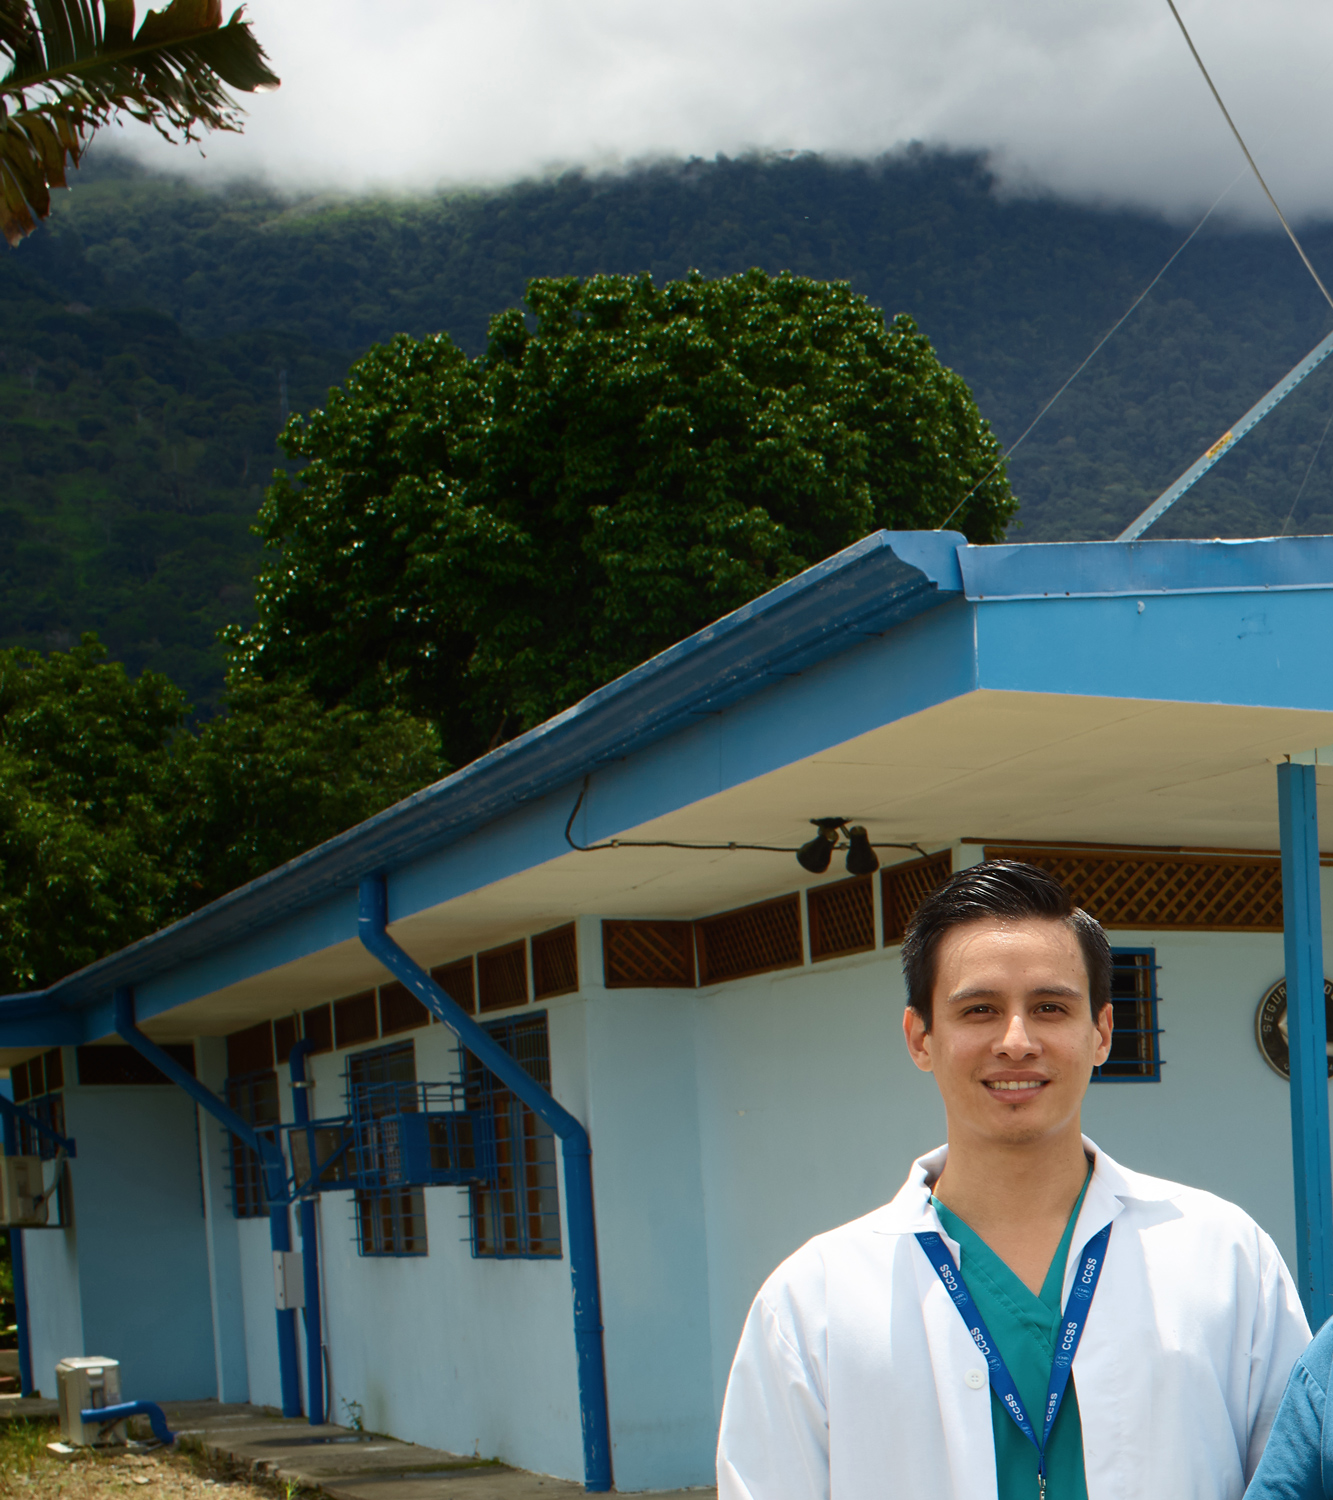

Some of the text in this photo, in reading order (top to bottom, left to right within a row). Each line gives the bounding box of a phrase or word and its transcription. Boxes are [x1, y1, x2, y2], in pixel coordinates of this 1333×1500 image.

[1262, 986, 1288, 1033] SEGUR
[939, 1263, 958, 1291] CCSS
[1081, 1257, 1098, 1284] CCSS
[970, 1326, 990, 1357] CCSS
[1062, 1321, 1078, 1351] CCSS
[1004, 1393, 1024, 1422] CCSS
[1046, 1392, 1058, 1422] CCSS
